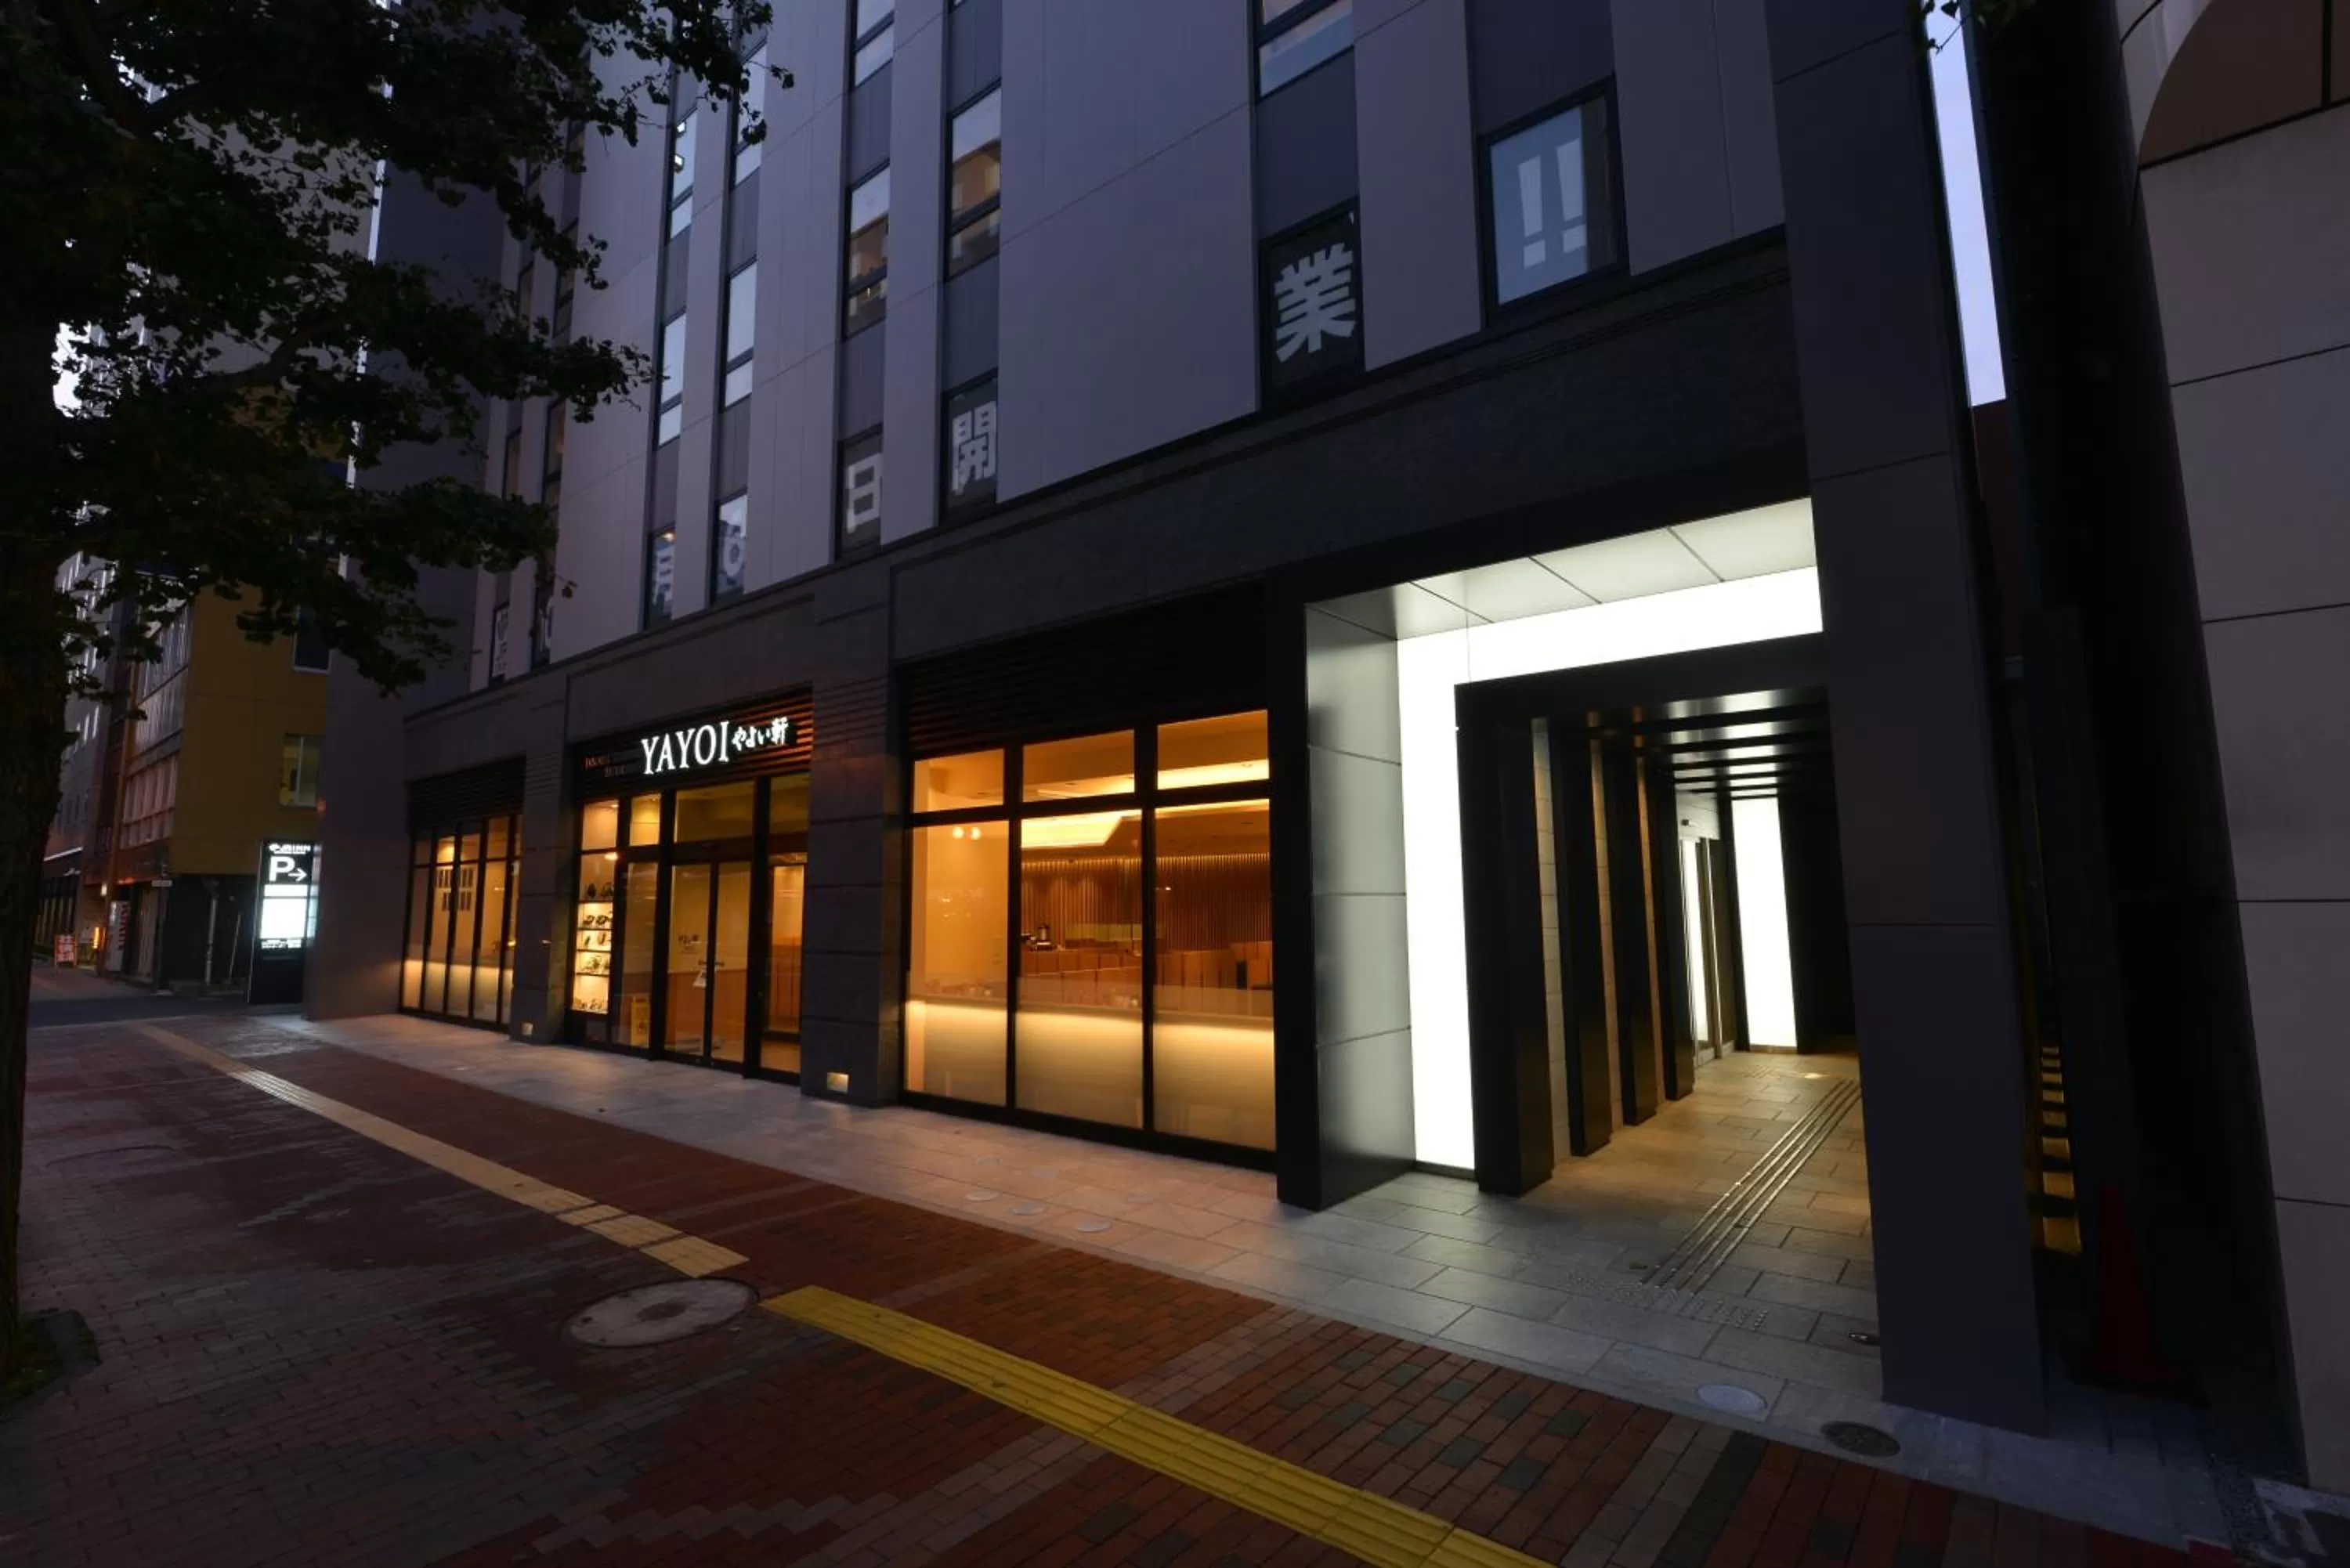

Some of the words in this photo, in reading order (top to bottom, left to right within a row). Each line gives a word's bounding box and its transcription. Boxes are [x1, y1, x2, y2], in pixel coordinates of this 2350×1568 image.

[1272, 241, 1358, 364] 業
[952, 399, 999, 496] 開
[845, 452, 884, 535] 日
[641, 721, 730, 775] YAYOI
[732, 717, 789, 751] やよい軒
[269, 855, 295, 882] P
